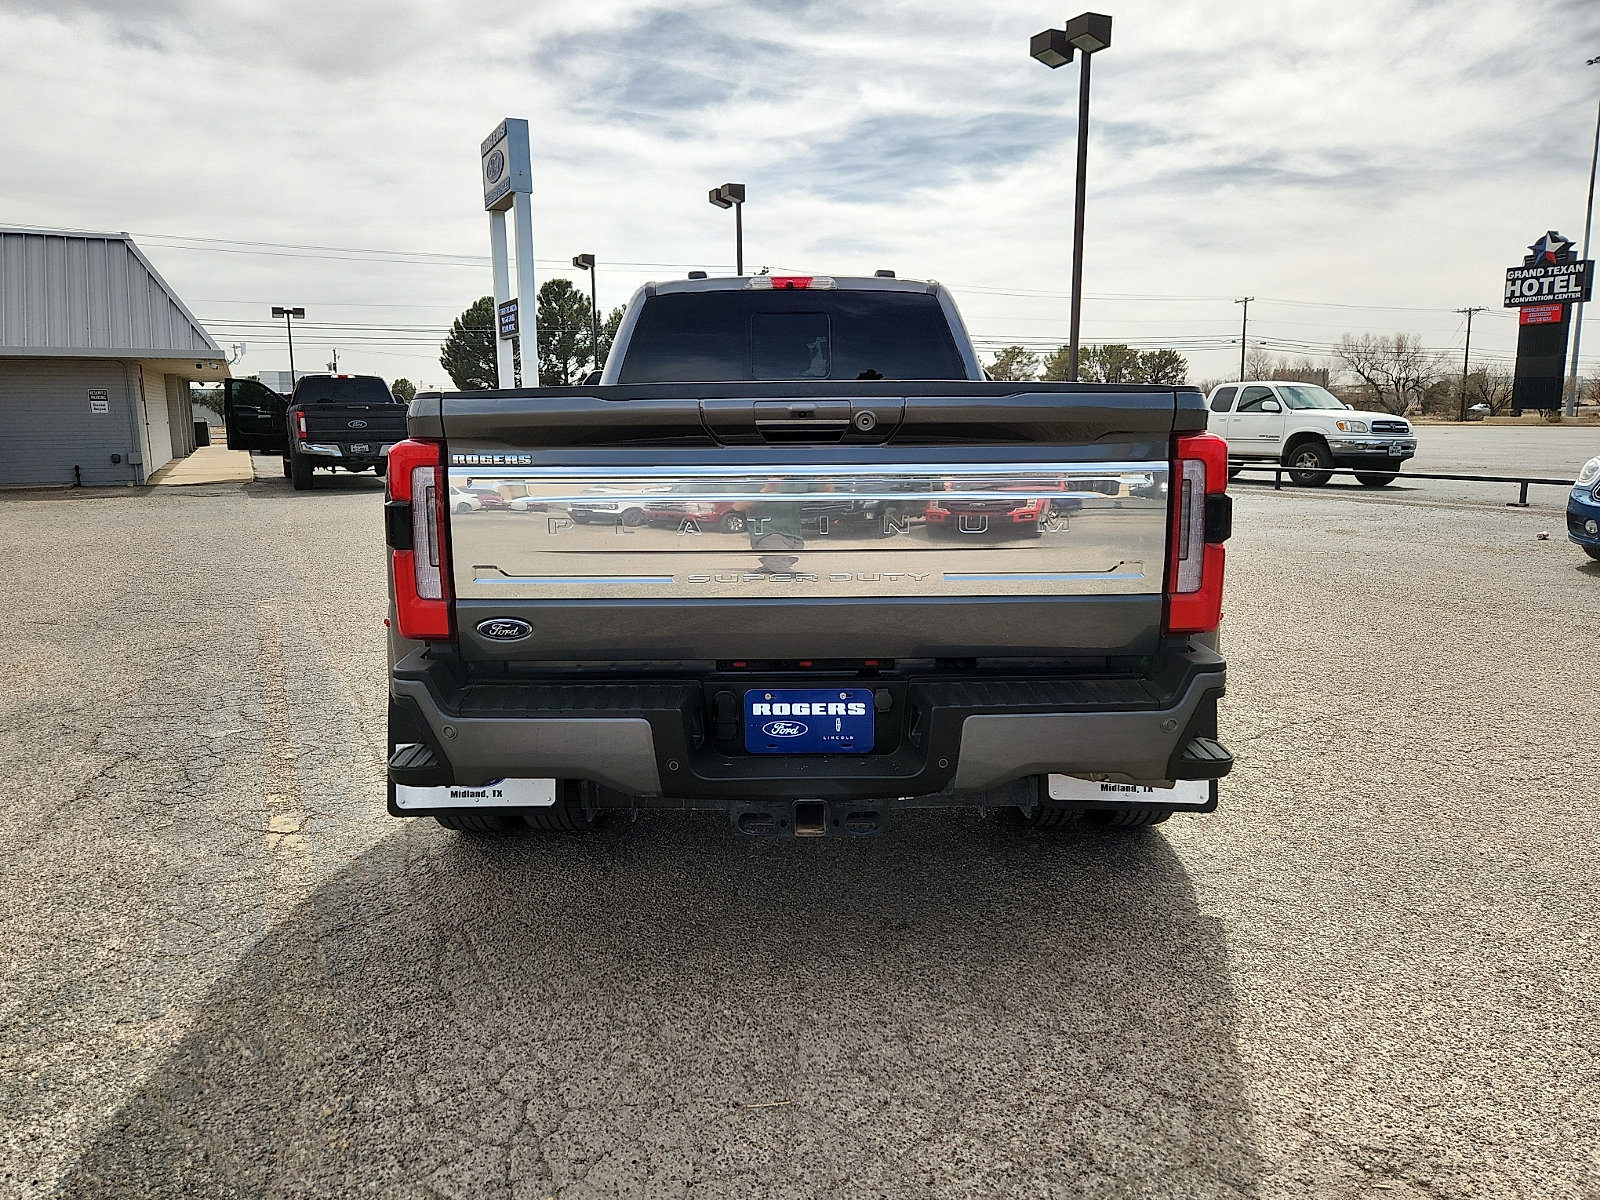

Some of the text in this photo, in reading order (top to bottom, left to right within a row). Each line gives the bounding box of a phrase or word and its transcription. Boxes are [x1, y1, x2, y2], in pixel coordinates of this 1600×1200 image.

[1507, 264, 1584, 279] GRAND TEXAN
[1505, 275, 1581, 297] HOTEL
[1511, 294, 1553, 303] CONVENTION
[1554, 292, 1581, 300] CENTER
[452, 454, 533, 465] ROGERS
[547, 514, 1071, 536] PLATINUM
[687, 572, 930, 584] SUPER DUTY
[488, 623, 520, 637] Ford
[752, 702, 866, 716] ROGERS
[770, 722, 800, 735] Ford
[450, 789, 503, 799] Midland, TX
[1100, 783, 1140, 793] Midland,
